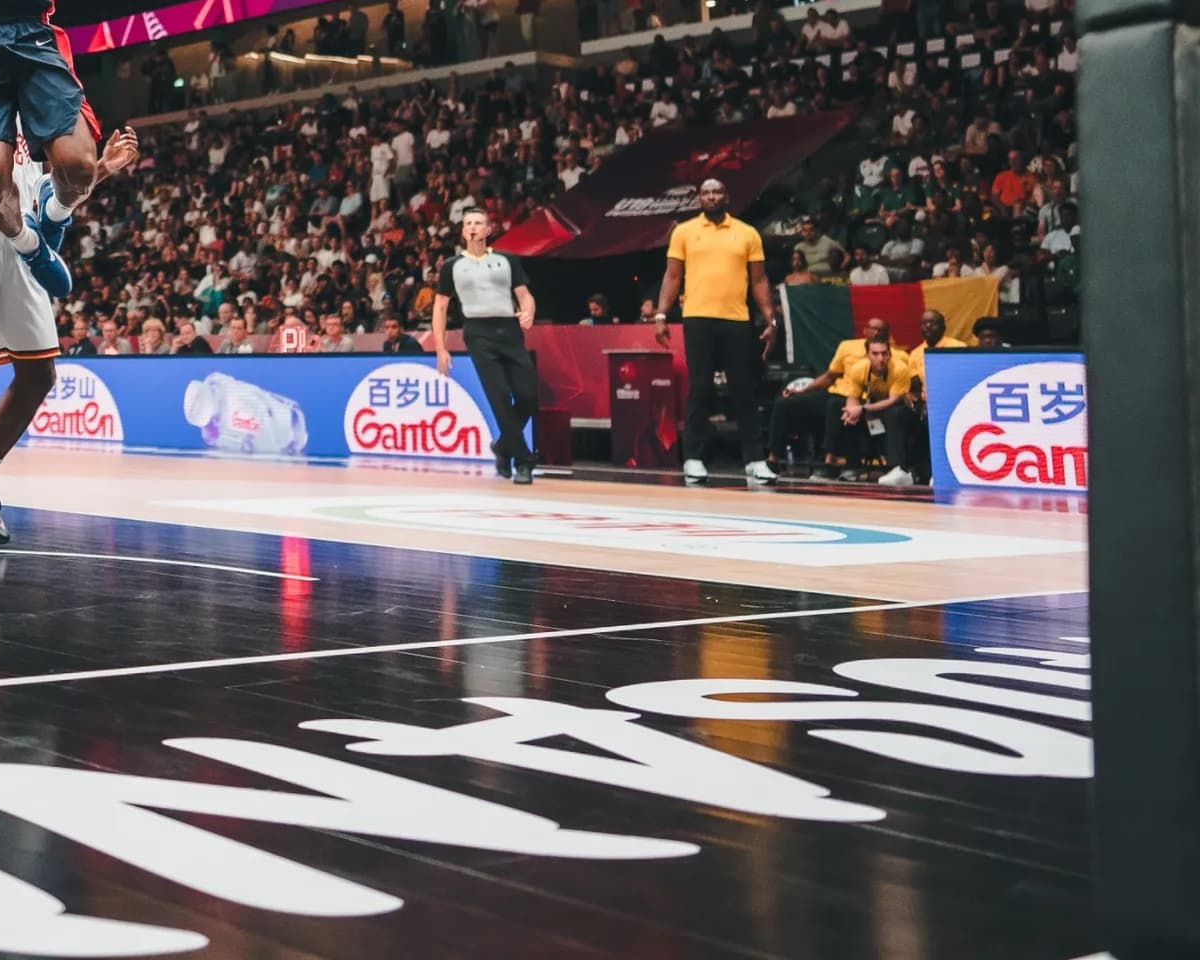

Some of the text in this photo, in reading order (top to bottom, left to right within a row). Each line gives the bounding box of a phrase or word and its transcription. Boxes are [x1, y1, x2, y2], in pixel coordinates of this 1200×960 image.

[368, 378, 449, 408] 百岁山
[986, 381, 1086, 424] 百岁
